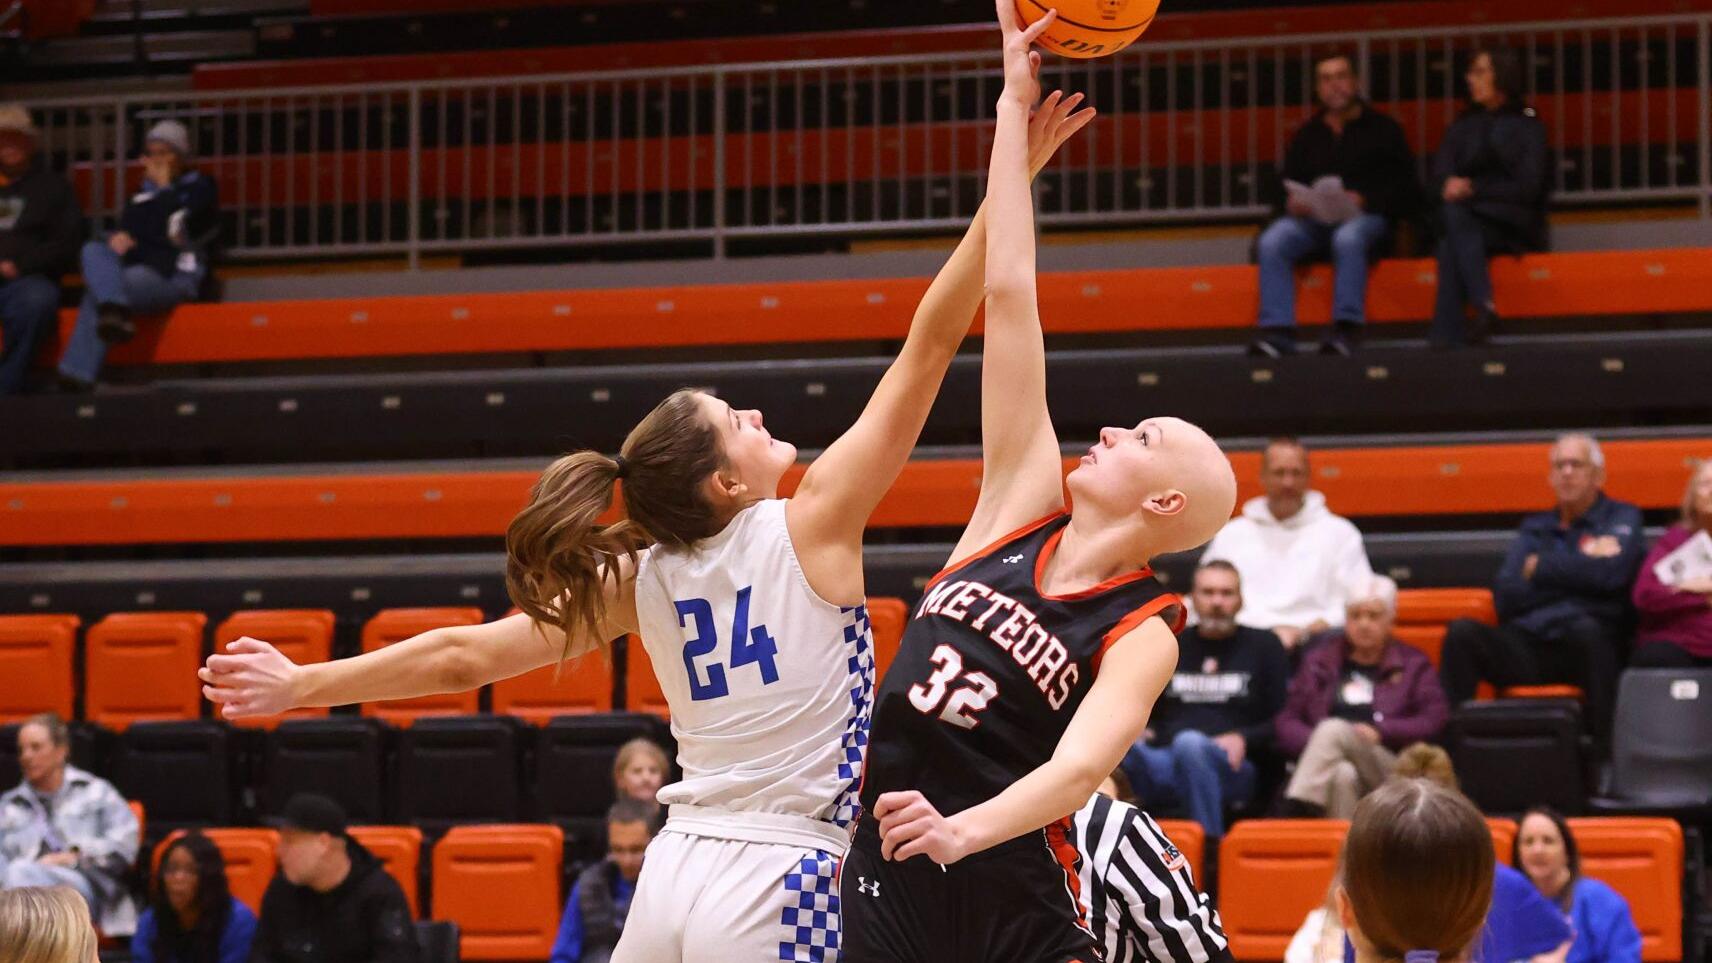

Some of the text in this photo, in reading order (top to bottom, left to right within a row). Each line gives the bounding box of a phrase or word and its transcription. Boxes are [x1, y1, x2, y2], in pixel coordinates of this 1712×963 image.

[673, 585, 780, 701] 24
[907, 643, 1000, 731] 32
[915, 580, 1080, 712] METEORS
